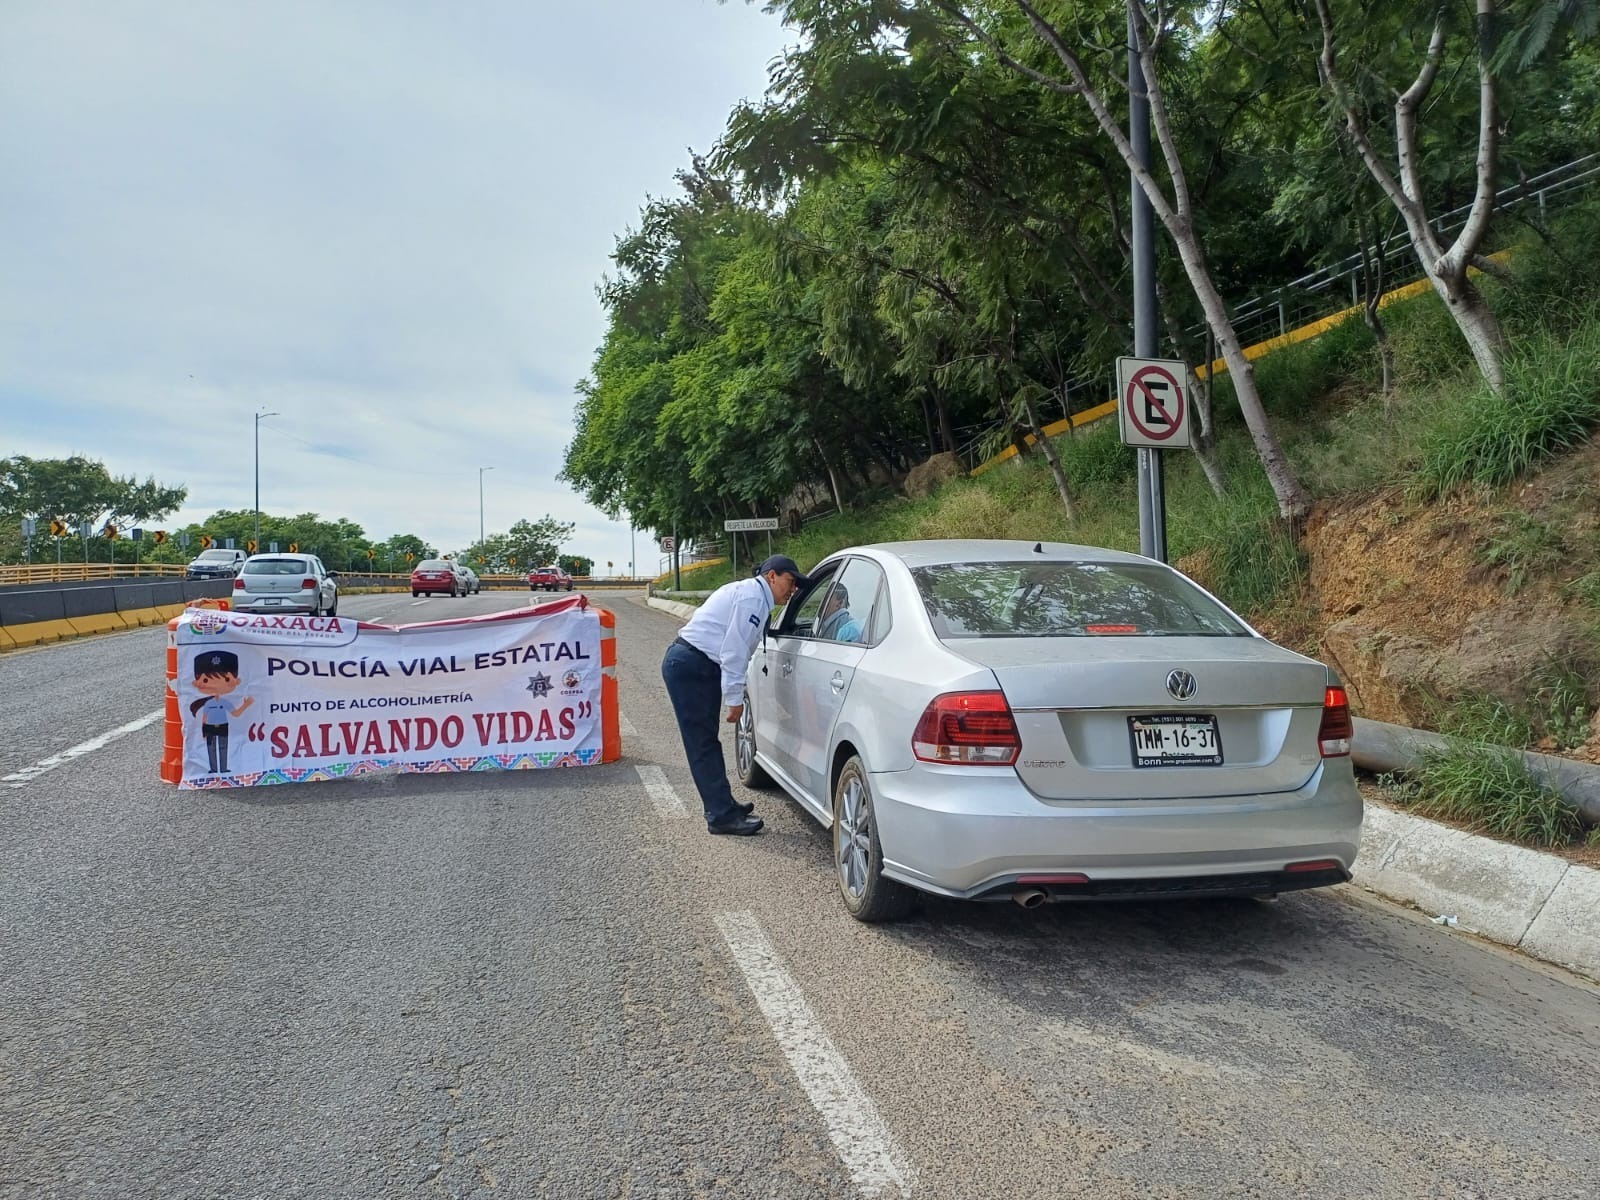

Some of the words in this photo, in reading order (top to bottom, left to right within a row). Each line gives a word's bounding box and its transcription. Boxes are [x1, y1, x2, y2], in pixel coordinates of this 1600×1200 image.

[1144, 381, 1170, 424] E
[726, 521, 746, 530] RESPETE
[753, 519, 777, 529] VELOCIDAD
[231, 616, 344, 634] OAXACA
[267, 656, 390, 678] POLICÍA
[398, 655, 466, 677] VIAL
[474, 641, 590, 670] ESTATAL
[270, 701, 321, 714] PUNTO
[326, 699, 346, 711] DE
[350, 691, 473, 710] ALCOHOLIMETRÍA
[1134, 728, 1215, 750] TMM-16-37
[1138, 758, 1162, 766] Bonn
